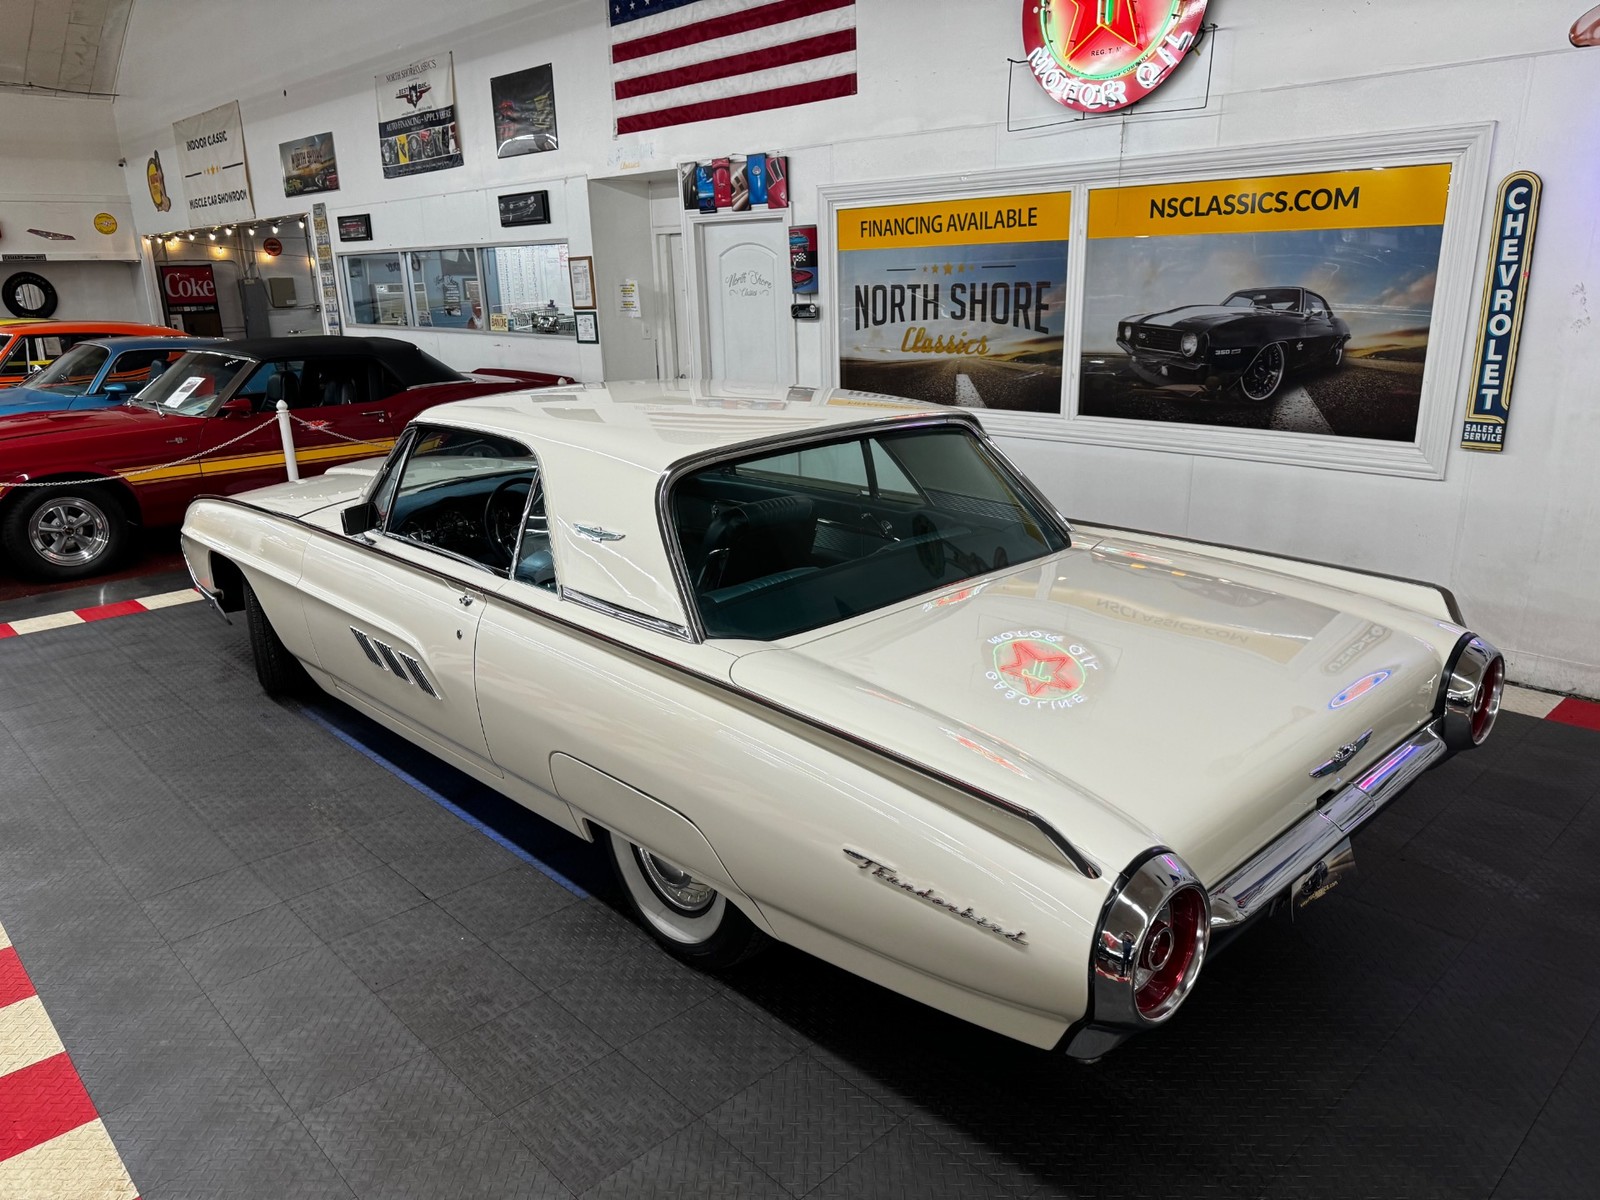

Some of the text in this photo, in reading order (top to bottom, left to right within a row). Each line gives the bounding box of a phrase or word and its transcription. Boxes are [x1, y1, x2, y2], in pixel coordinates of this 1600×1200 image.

[1028, 31, 1195, 109] MOTOR OIL
[423, 112, 439, 123] APPLY
[186, 130, 228, 151] INDOOR CLASSIC
[189, 188, 248, 210] MUSCLE CAR SHOWROOM
[1149, 186, 1360, 219] NSCLASSICS.COM
[860, 207, 1038, 238] FINANCING AVAILABLE
[164, 272, 215, 298] Coke
[1480, 186, 1529, 410] CHEVROLET
[854, 281, 1051, 335] NORTH SHORE
[900, 326, 991, 356] Classics
[1463, 431, 1503, 442] SERVICE
[1465, 423, 1503, 434] SALES &
[843, 848, 1029, 947] Thunderbird
